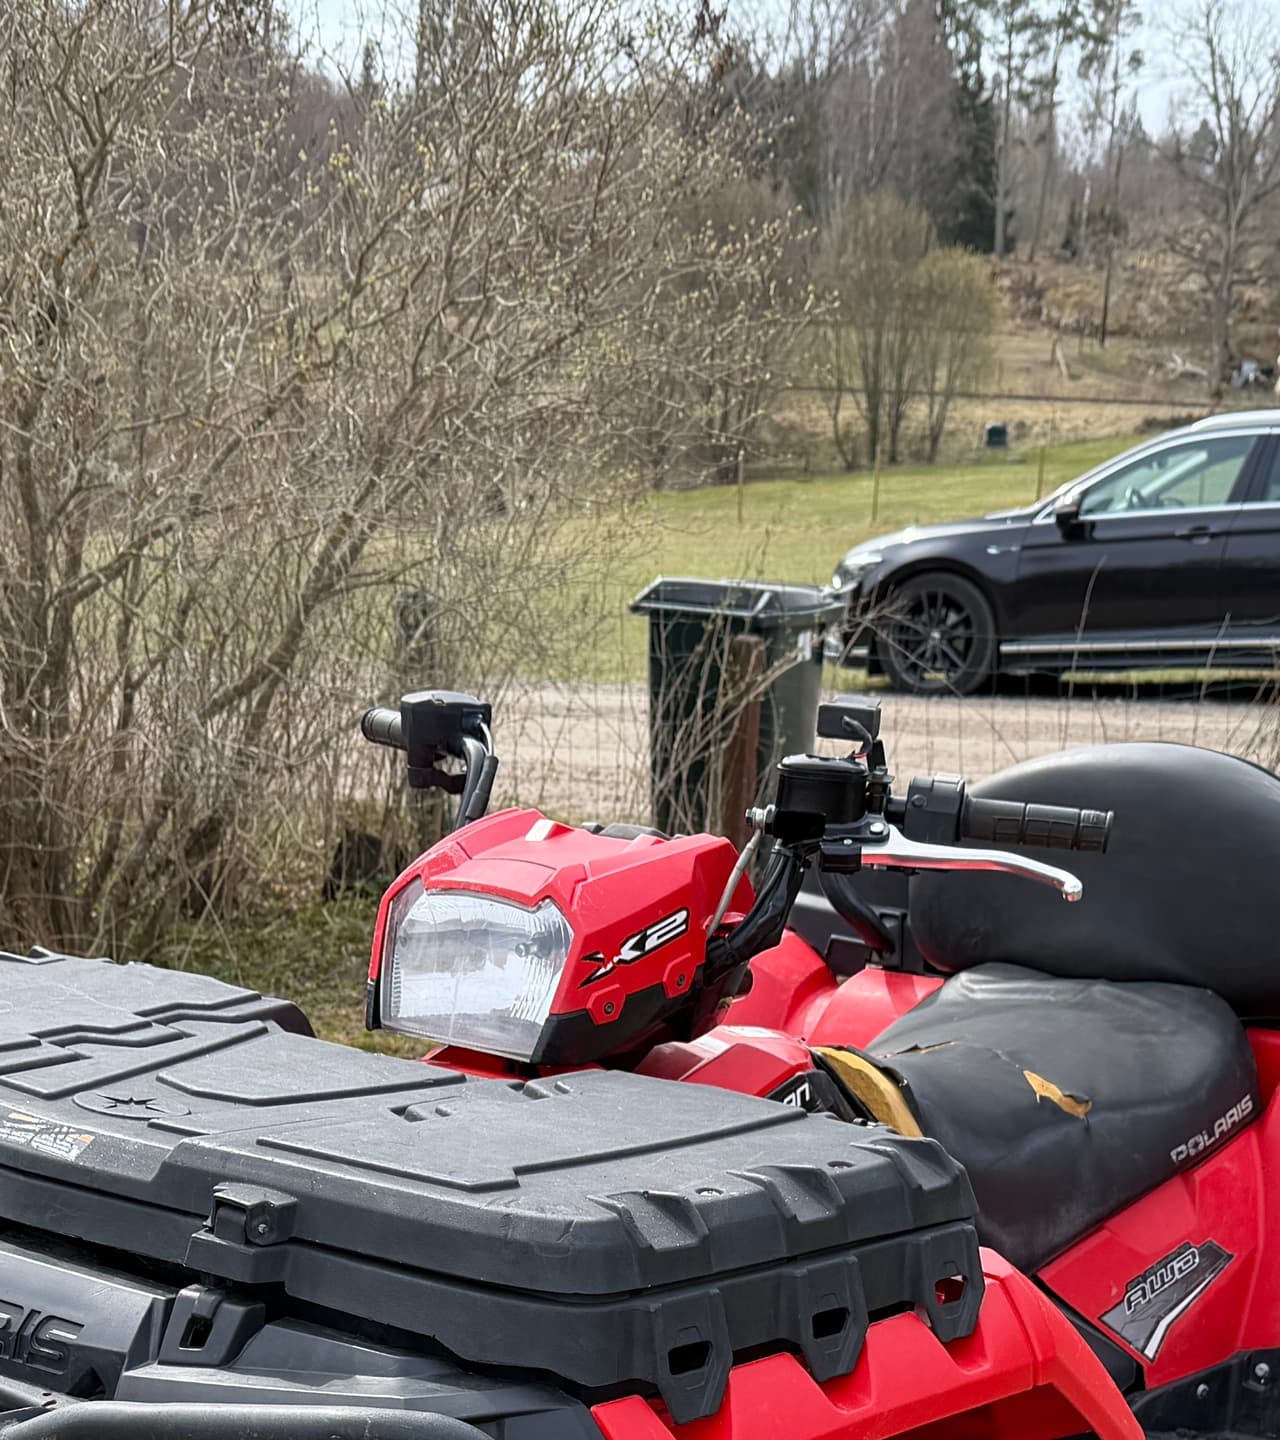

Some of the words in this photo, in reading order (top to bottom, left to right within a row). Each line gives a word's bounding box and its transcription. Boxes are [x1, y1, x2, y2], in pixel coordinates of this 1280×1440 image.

[580, 908, 689, 988] X2
[1169, 1093, 1254, 1165] POLARIS
[1124, 1248, 1200, 1315] AWD
